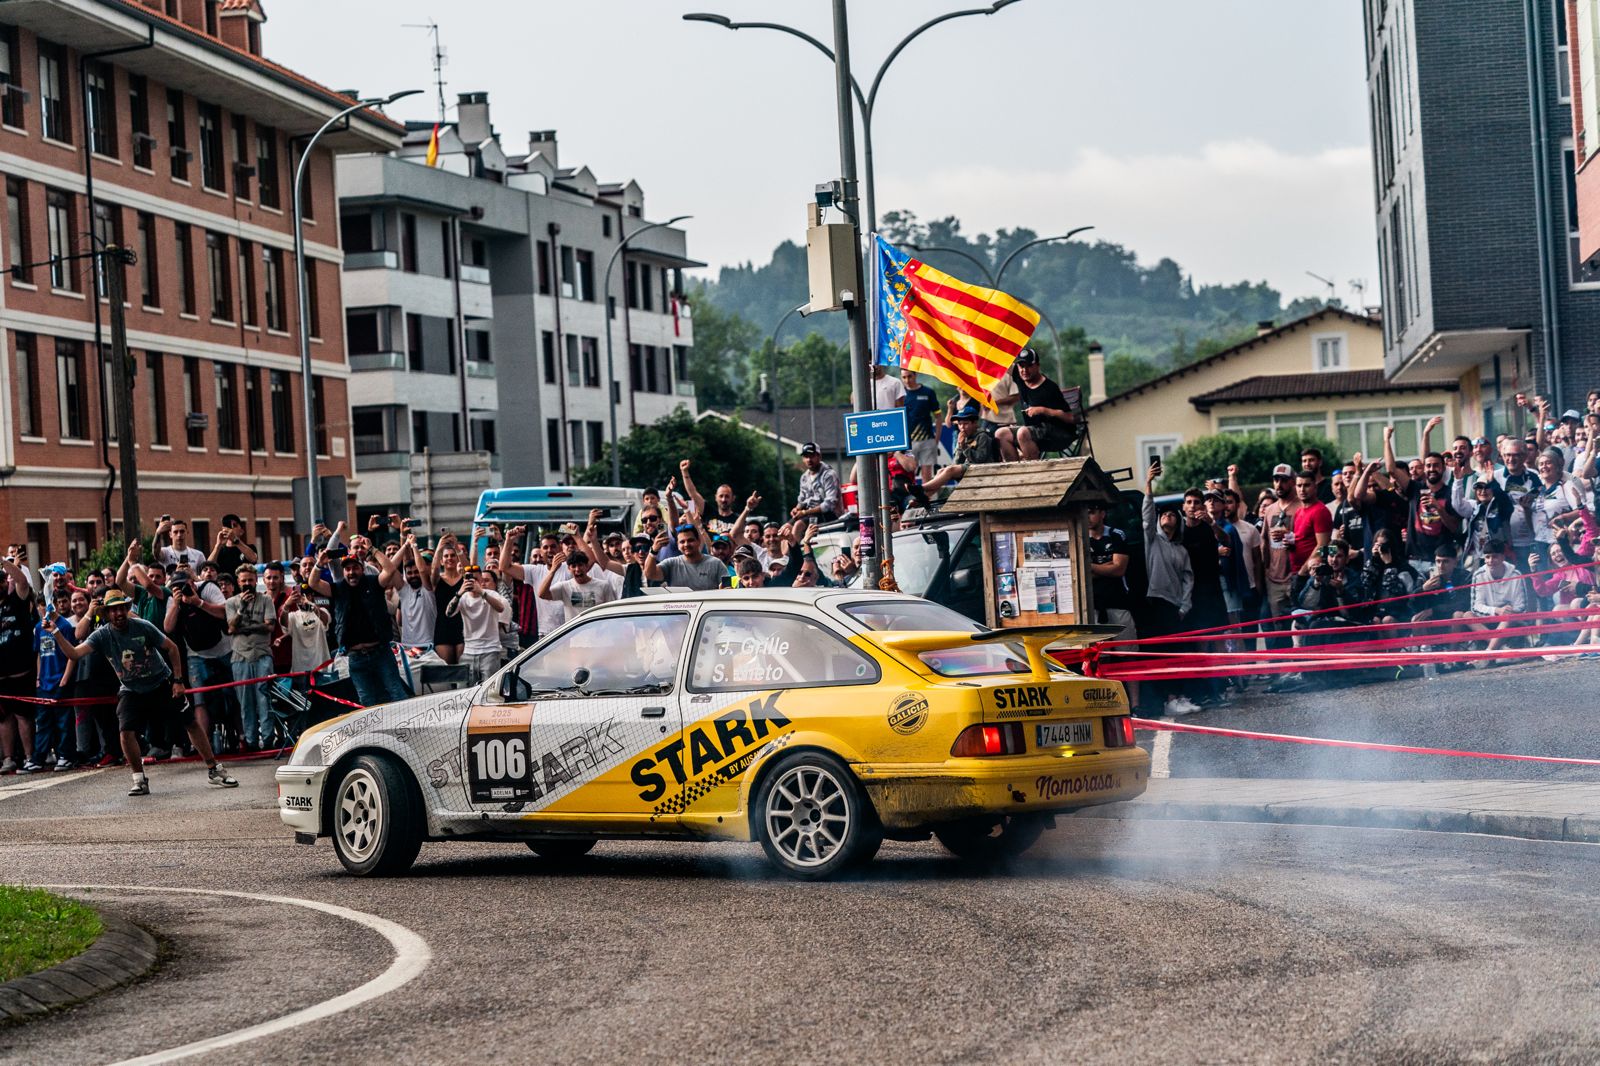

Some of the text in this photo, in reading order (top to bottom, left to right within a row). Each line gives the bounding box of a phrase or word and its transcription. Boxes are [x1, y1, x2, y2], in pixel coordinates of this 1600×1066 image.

[867, 434, 895, 444] El Cruce
[742, 637, 790, 656] Grille
[713, 664, 729, 683] S.
[993, 686, 1053, 709] STARK
[1083, 687, 1111, 701] GRILLE
[492, 709, 512, 719] 2025
[889, 702, 927, 725] GALICIA
[321, 708, 382, 754] STARK
[1043, 724, 1092, 744] 7448 HNM
[630, 689, 792, 802] STARK
[471, 738, 526, 780] 106
[729, 763, 739, 775] BY
[285, 796, 313, 807] STARK
